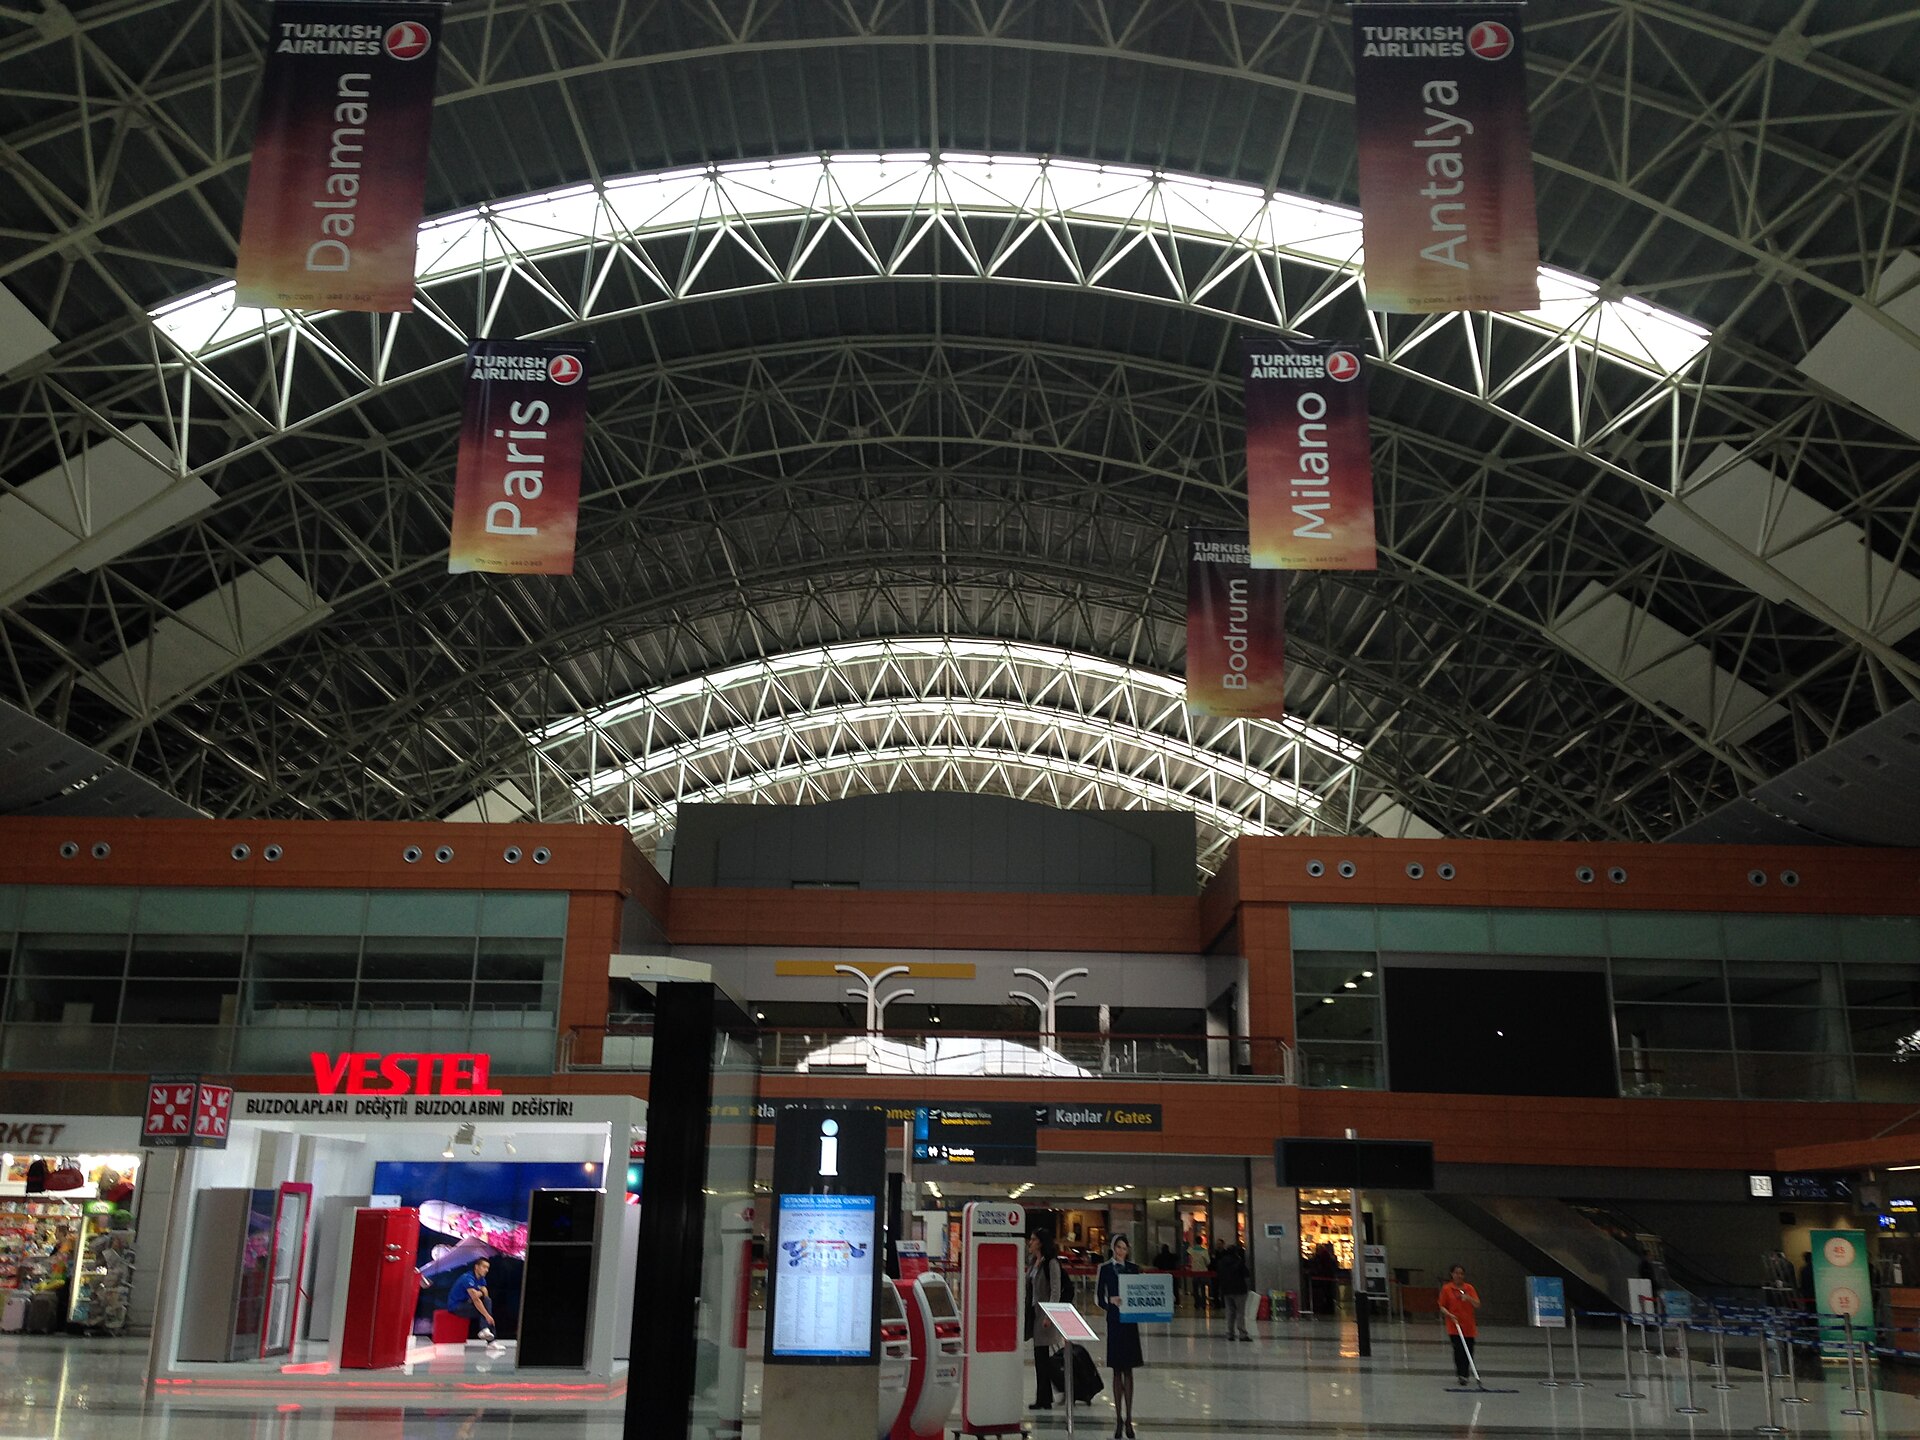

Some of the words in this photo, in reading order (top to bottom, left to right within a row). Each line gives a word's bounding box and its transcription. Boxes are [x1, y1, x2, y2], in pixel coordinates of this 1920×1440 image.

[280, 23, 382, 39] TURKISH
[1362, 26, 1464, 41] TURKISH
[277, 39, 381, 56] AIRLINES
[1362, 42, 1465, 57] AIRLINES
[305, 72, 372, 272] Dalaman
[1413, 79, 1475, 271] Antalya
[473, 355, 548, 369] TURKISH
[1250, 354, 1324, 367] TURKISH
[471, 368, 547, 382] AIRLINES
[1250, 367, 1325, 379] AIRLINES
[485, 399, 551, 536] Paris
[1290, 392, 1333, 539] Milano
[1193, 541, 1250, 554] TURKISH
[1193, 552, 1250, 564] AIRLINES
[1223, 579, 1248, 690] Bodrum
[310, 1052, 502, 1095] VESTEL
[246, 1098, 347, 1114] BUZDOLAPLARI
[415, 1099, 504, 1116] BUZDOLABINI
[1055, 1108, 1102, 1126] Kapılar
[1114, 1110, 1153, 1124] Gates
